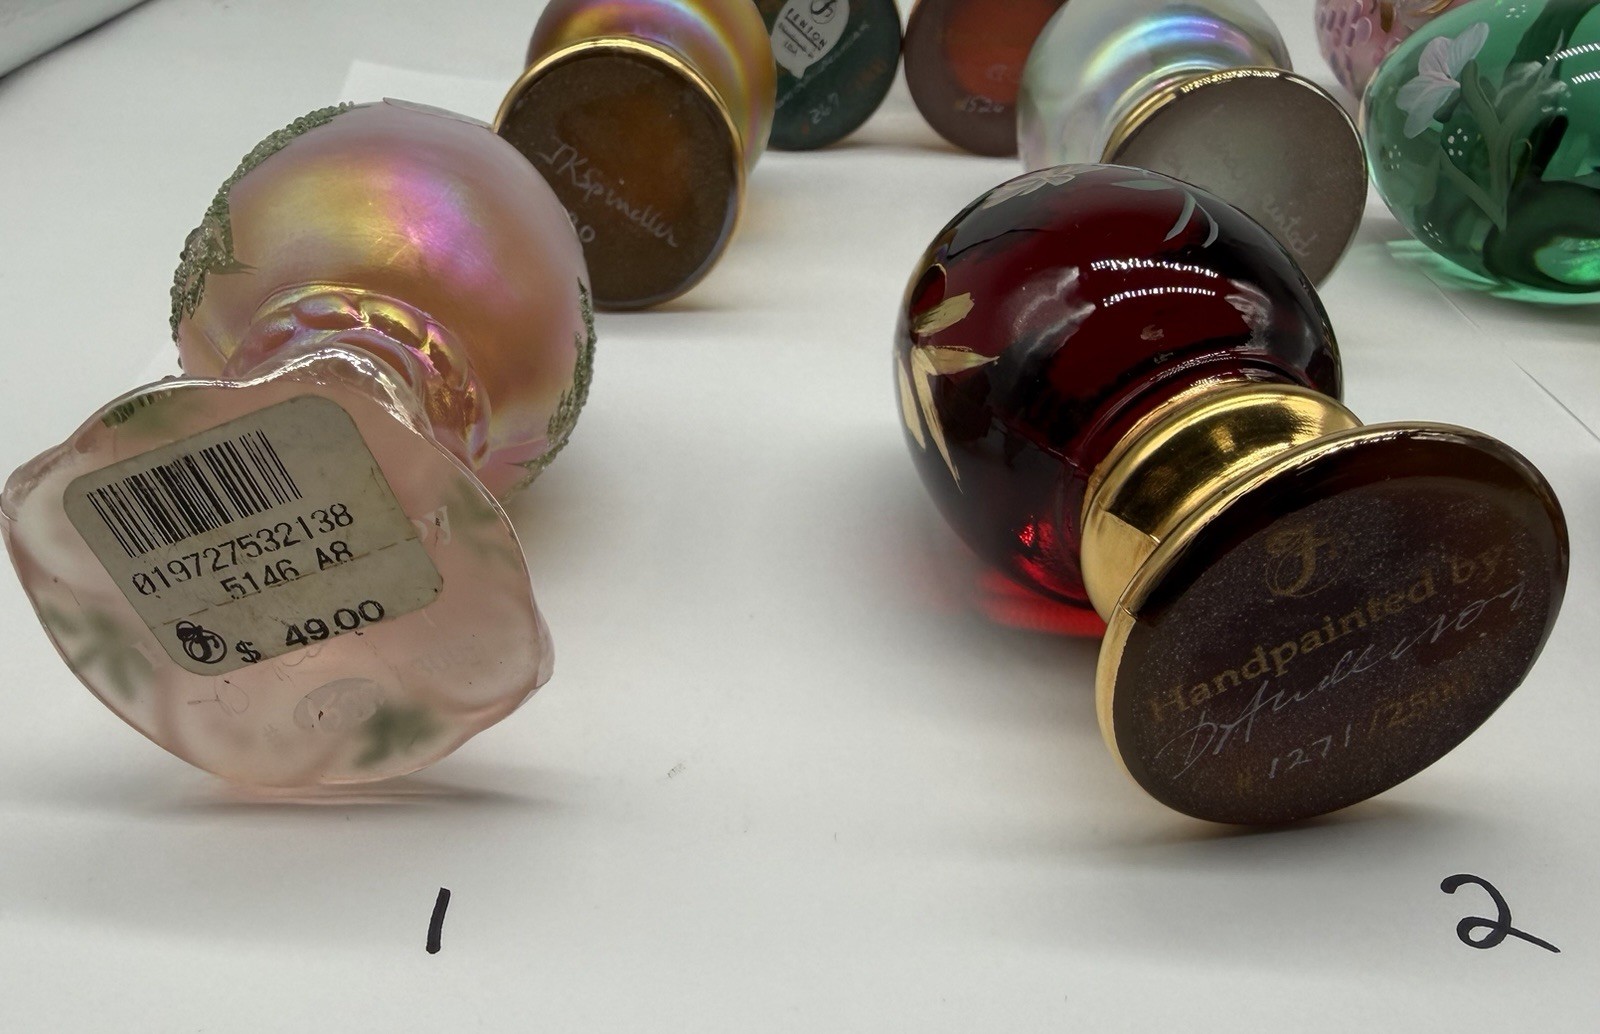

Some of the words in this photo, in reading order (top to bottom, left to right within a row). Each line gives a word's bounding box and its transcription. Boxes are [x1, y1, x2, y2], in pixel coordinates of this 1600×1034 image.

[131, 502, 354, 597] 019727532138
[219, 558, 300, 600] 5146
[315, 540, 354, 571] A8
[285, 599, 386, 647] 49.00
[1151, 567, 1436, 723] Handpainted
[1451, 543, 1506, 586] by
[426, 886, 451, 954] 1
[1440, 873, 1561, 953] 2
